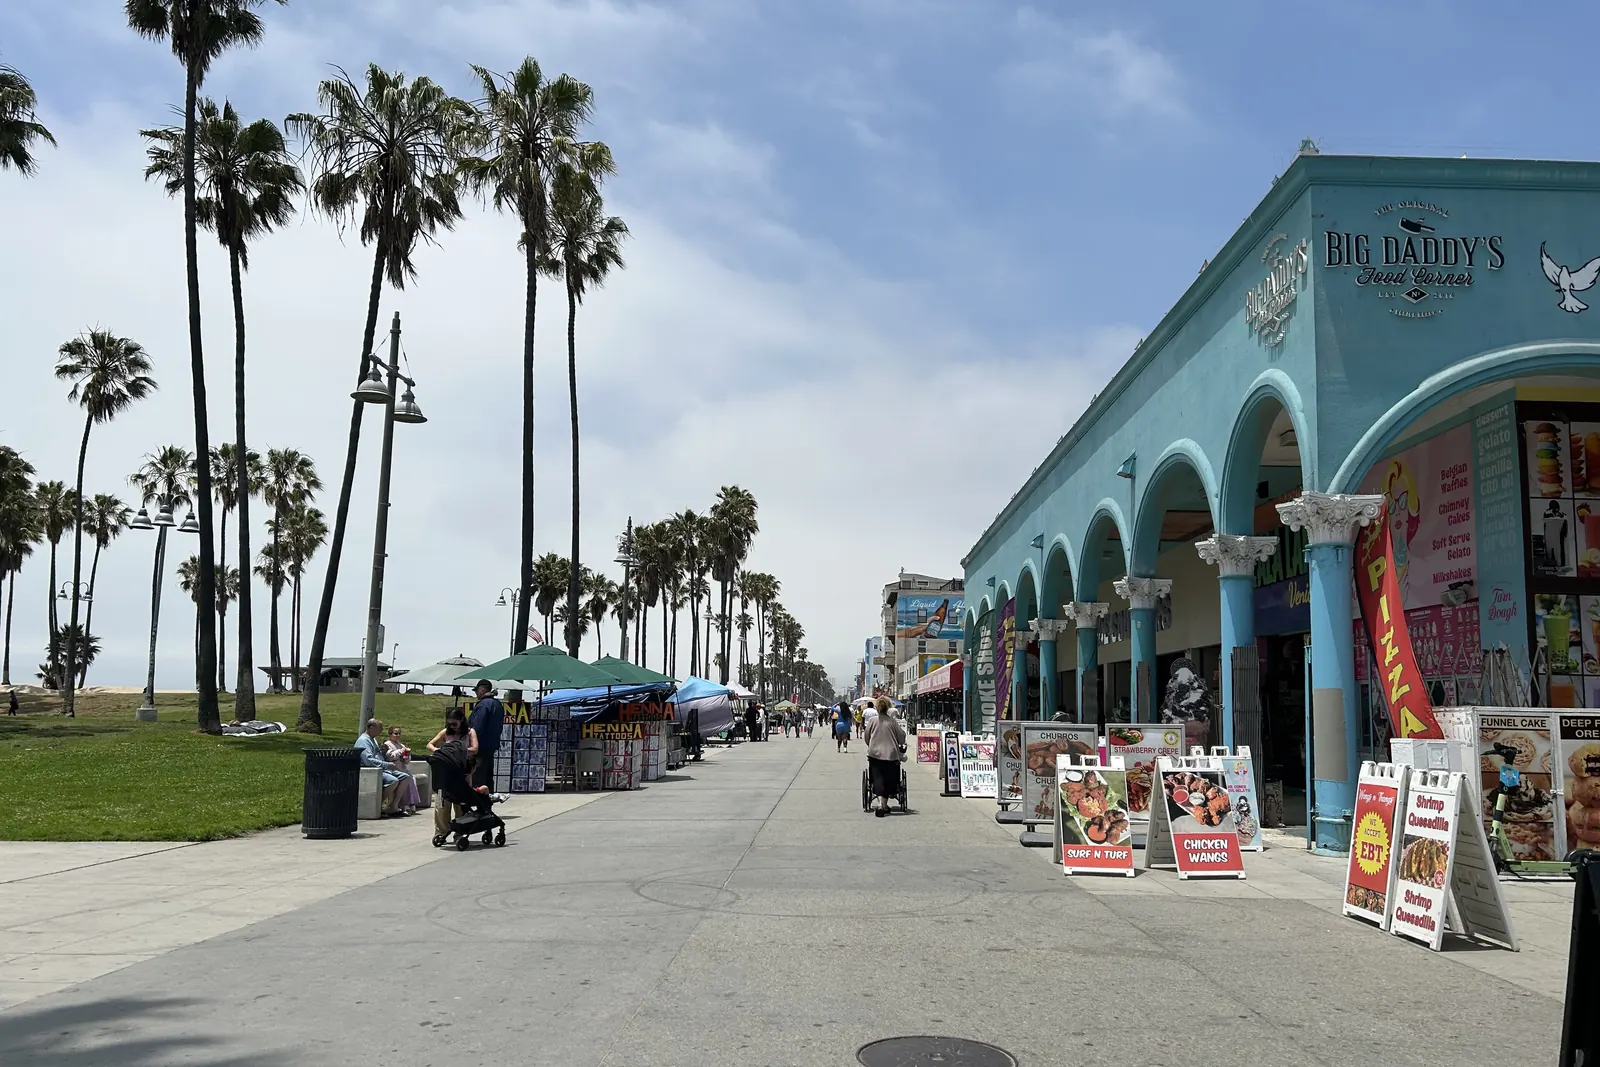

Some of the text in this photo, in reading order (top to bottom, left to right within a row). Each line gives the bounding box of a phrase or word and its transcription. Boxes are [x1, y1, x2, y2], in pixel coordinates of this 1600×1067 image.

[1374, 200, 1449, 218] THE ORIGINAL
[1324, 231, 1371, 267] BIG
[1381, 235, 1506, 270] DADDY'S
[1355, 267, 1475, 287] Food Corner
[1478, 429, 1511, 456] gelato
[1441, 463, 1468, 480] Belgian
[1480, 458, 1513, 479] vanilla
[1441, 477, 1468, 494] Waffles
[1480, 473, 1514, 495] CBD oil
[1439, 497, 1470, 515] Chimney
[1448, 511, 1471, 526] Cakes
[1432, 532, 1471, 551] Soft Serve
[1448, 547, 1471, 560] Gelato
[1432, 567, 1472, 584] Milkshakes
[1288, 581, 1310, 608] Veni
[910, 600, 937, 608] Liquid
[1488, 601, 1517, 621] Dough
[977, 625, 995, 676] SHOP
[1366, 556, 1429, 739] PIZZA
[619, 702, 675, 721] HENNA
[978, 680, 996, 741] SMOKE
[582, 723, 643, 740] HENNA
[1481, 718, 1547, 728] FUNNEL CAKE
[1562, 719, 1592, 728] DEEP
[593, 731, 633, 740] TATTOOS
[1040, 732, 1079, 741] CHURROS
[1114, 746, 1157, 754] STRAWBERRY
[948, 747, 959, 777] ATM
[1416, 795, 1444, 814] Shrimp
[1370, 818, 1377, 826] WE
[1408, 812, 1449, 832] Quesadilla
[1364, 828, 1381, 838] ACCEPT
[1184, 839, 1228, 850] CHICKEN
[1360, 841, 1383, 863] EBT
[1067, 849, 1128, 860] SURF N TURF
[1189, 852, 1228, 863] WANGS
[1404, 889, 1432, 912] Shrimp
[1395, 907, 1435, 932] Quesadilla
